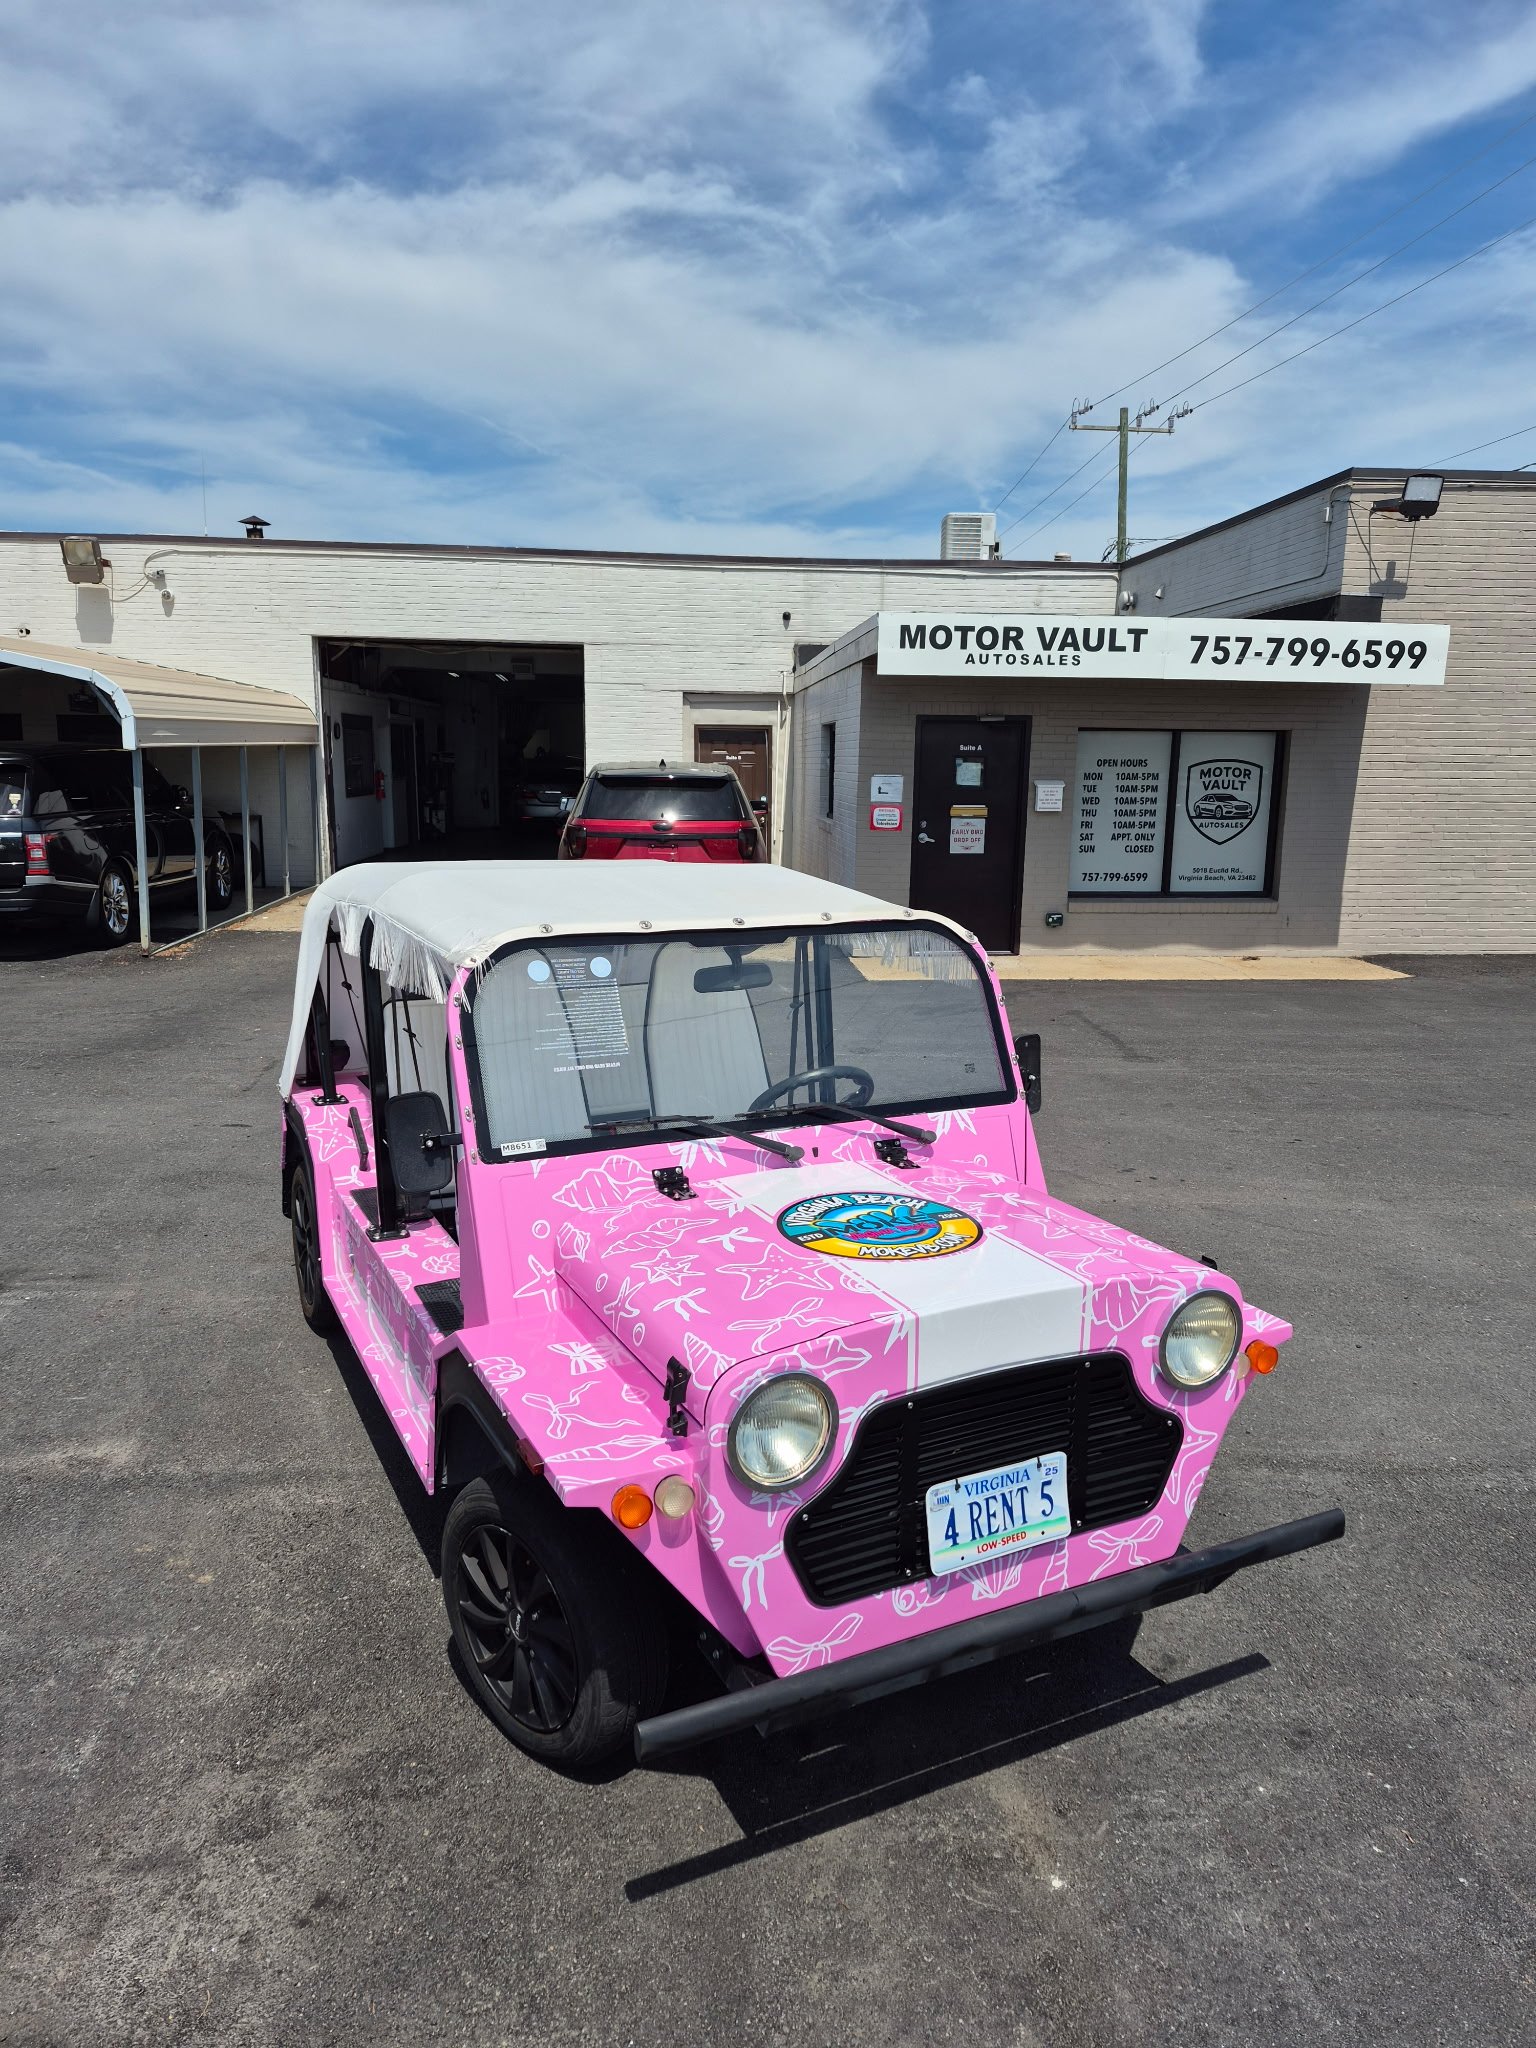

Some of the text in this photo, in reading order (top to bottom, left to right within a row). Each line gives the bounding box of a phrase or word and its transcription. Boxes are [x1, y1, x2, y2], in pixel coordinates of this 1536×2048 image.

[899, 624, 1149, 653] MOTOR VAULT
[1189, 635, 1429, 670] 757-799-6599
[965, 653, 1083, 667] AUTOSALES
[1096, 758, 1148, 768] OPEN HOURS
[1083, 772, 1160, 781] MON 10AM-5PM
[1200, 766, 1252, 780] MOTOR
[1083, 784, 1159, 793] TUE 10AM-5PM
[1202, 780, 1246, 791] VAULT
[1082, 797, 1158, 805] WED 10AM-5PM
[1081, 809, 1157, 817] THU 10AM-5PM
[1080, 821, 1156, 829] FRI 10AM-5PM
[1080, 833, 1155, 841] SAT APPT. ONLY
[1079, 845, 1154, 853] SUN CLOSED
[1082, 872, 1148, 882] 757-799-6599
[785, 1195, 927, 1226] VIRGINIA BEACH
[798, 1232, 824, 1241] ESTD
[858, 1232, 972, 1257] MOKEVB.COM
[1045, 1466, 1058, 1476] 25
[964, 1469, 1031, 1497] VIRGINIA
[944, 1479, 1054, 1547] 4 RENT 5
[977, 1531, 1027, 1554] LOW-SPEED
